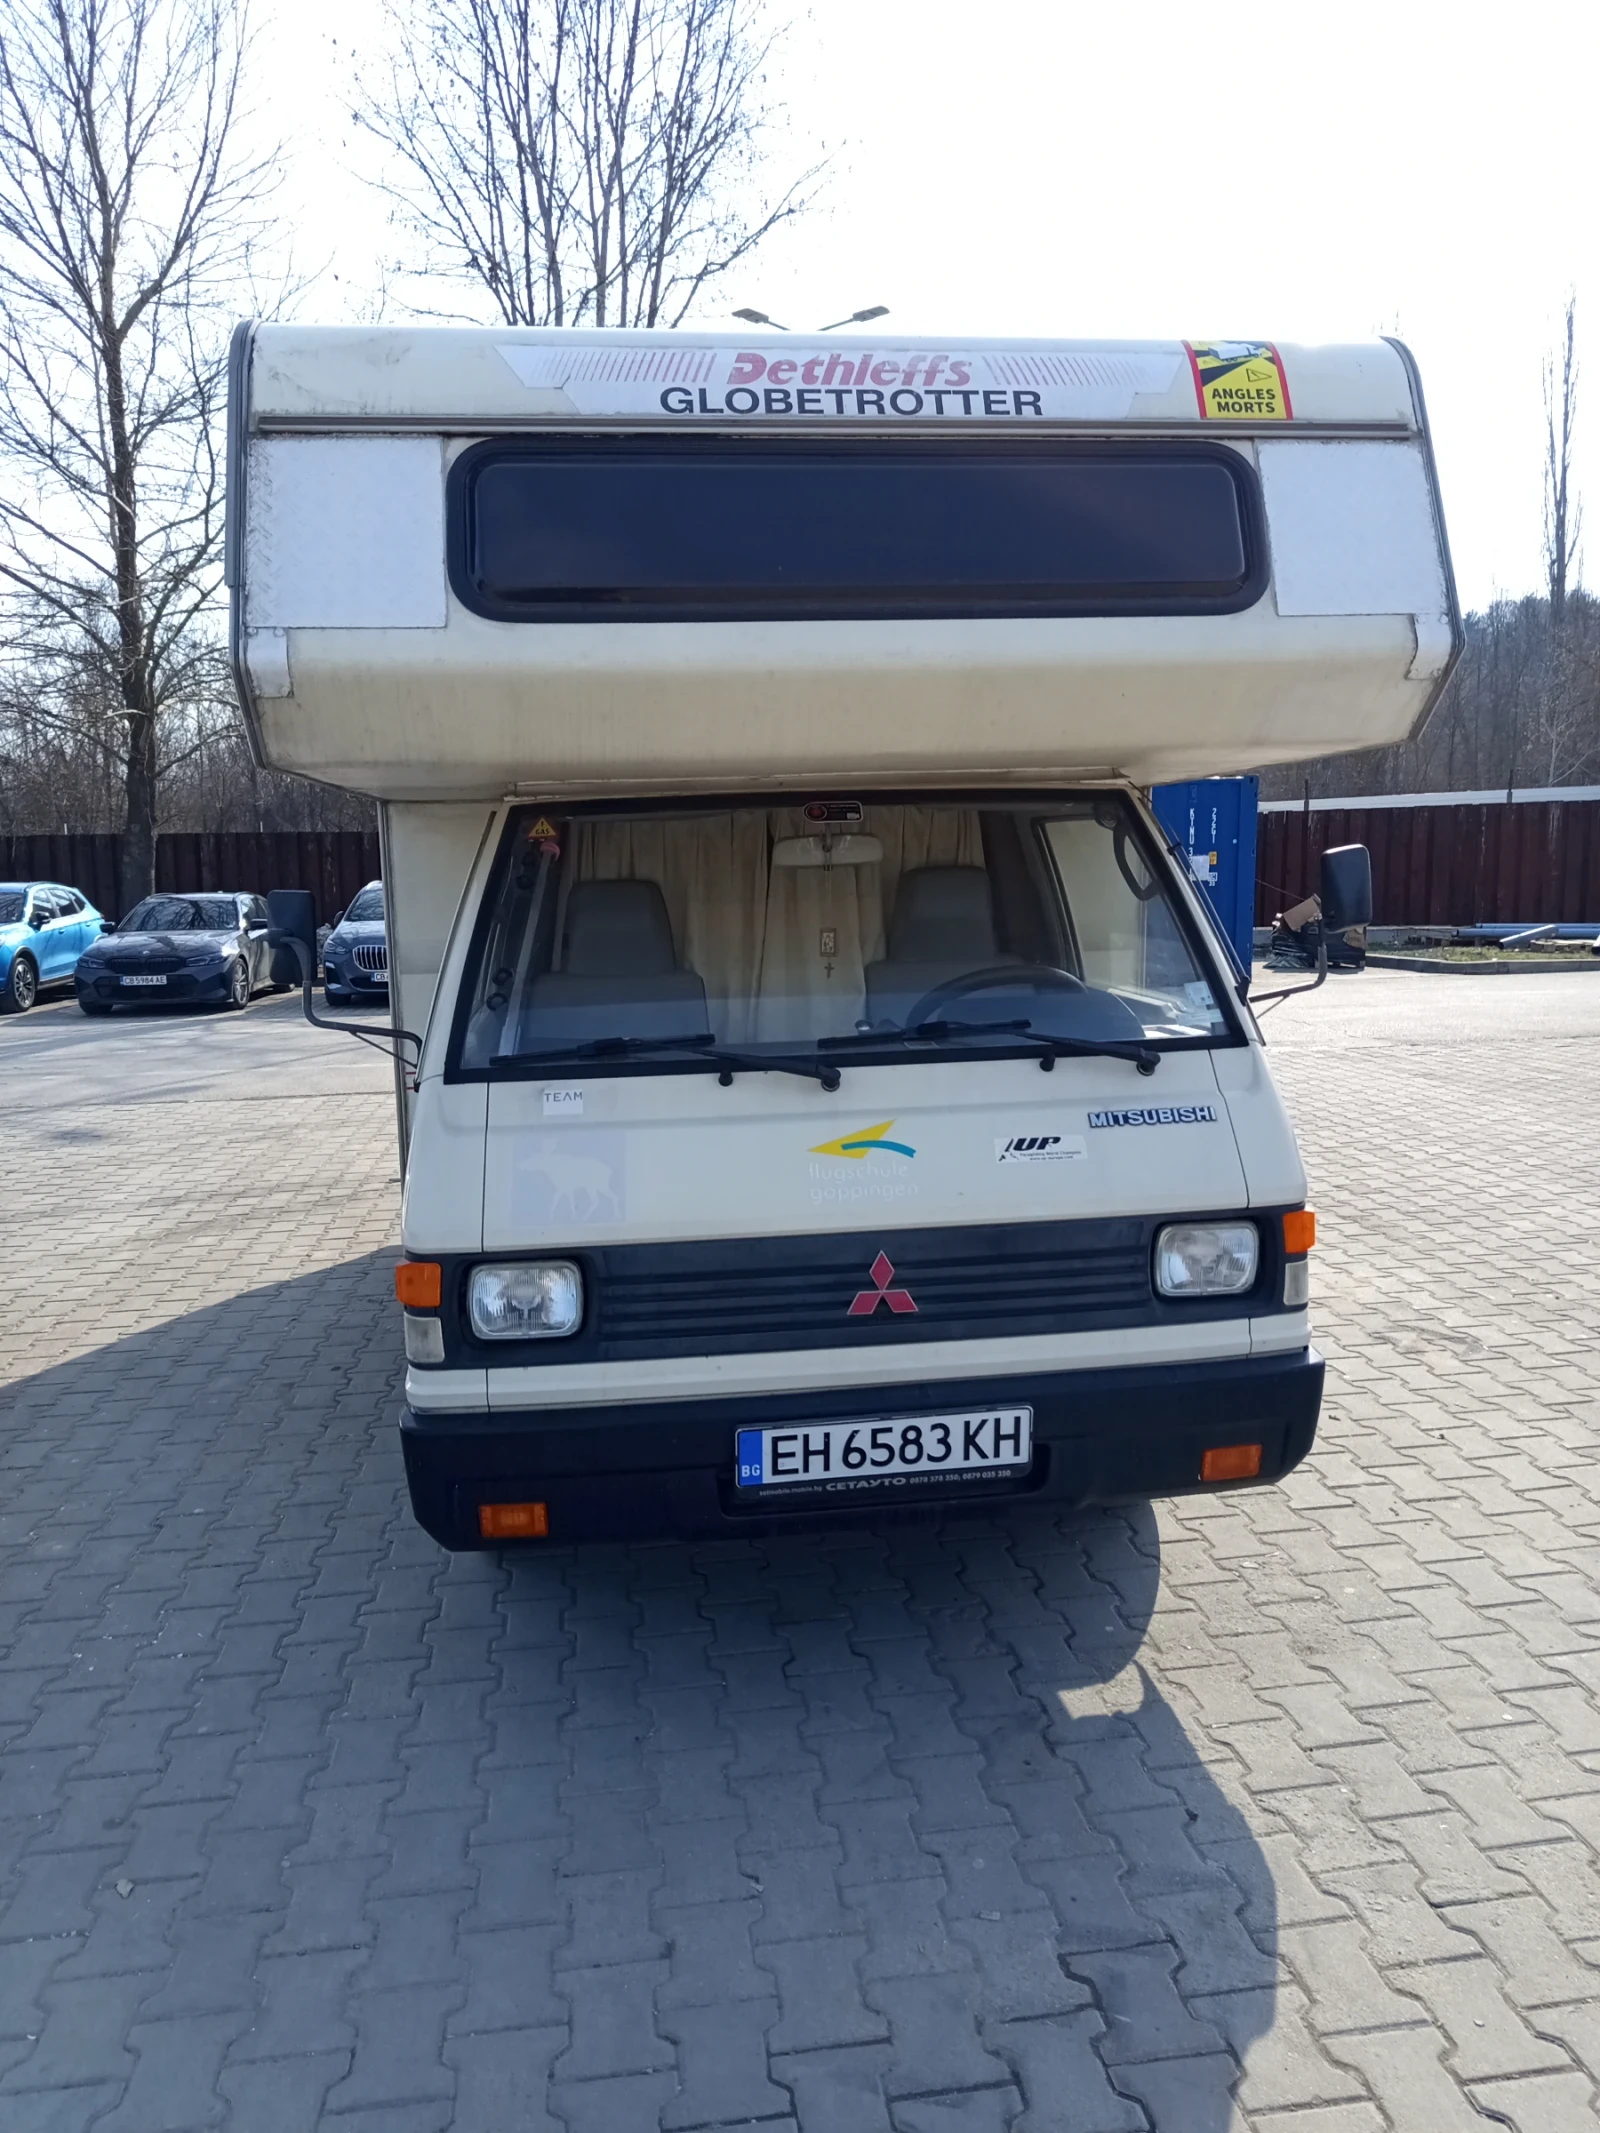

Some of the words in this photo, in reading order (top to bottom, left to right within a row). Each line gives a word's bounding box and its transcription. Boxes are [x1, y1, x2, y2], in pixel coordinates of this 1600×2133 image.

[727, 352, 972, 386] Dethleffs
[1212, 388, 1276, 400] ANGLES
[660, 387, 1043, 416] GLOBETROTTER
[1216, 401, 1276, 413] MORTS
[544, 1091, 583, 1103] TEAM
[1088, 1106, 1217, 1128] MITSUBISHI
[1013, 1136, 1061, 1151] UP
[771, 1432, 831, 1476] EH
[842, 1422, 952, 1470] 6583
[963, 1415, 1022, 1461] KH
[741, 1465, 761, 1477] BG
[962, 1472, 980, 1480] 0879
